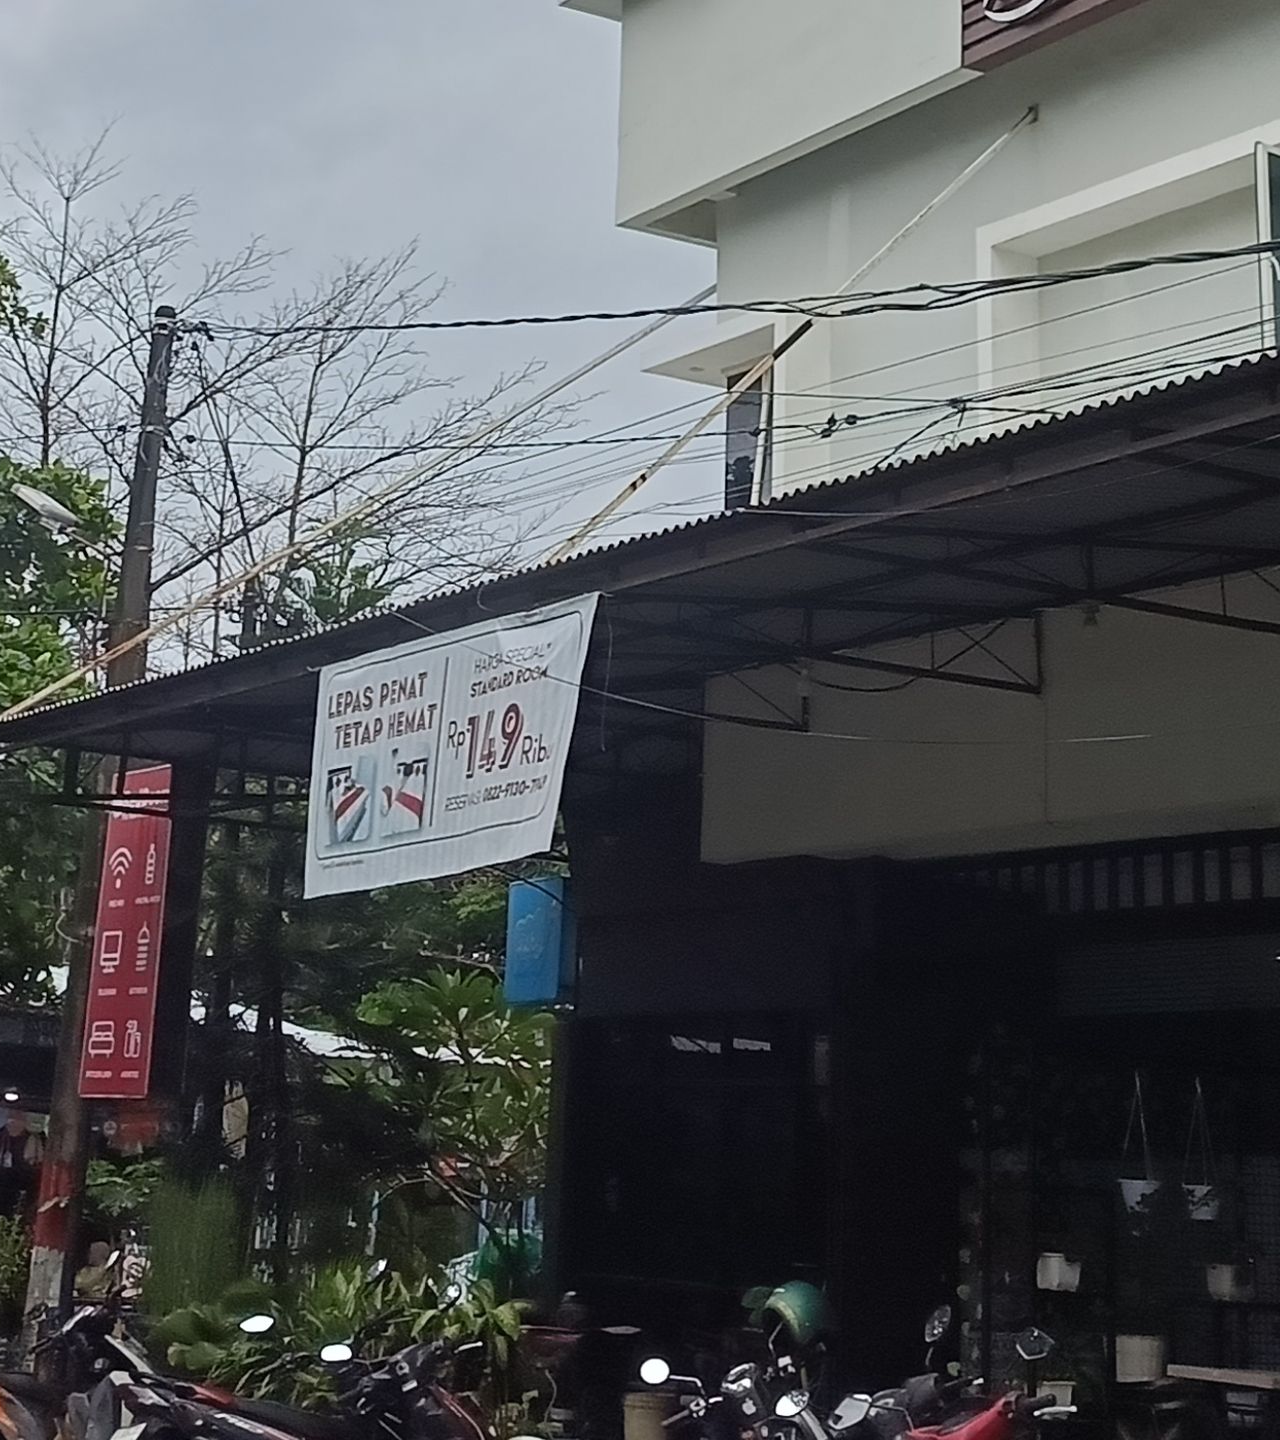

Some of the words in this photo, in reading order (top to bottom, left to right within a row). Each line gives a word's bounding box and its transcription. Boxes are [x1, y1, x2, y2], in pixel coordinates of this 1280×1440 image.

[328, 686, 374, 719] LEPAS
[380, 672, 428, 708] PENAT
[335, 717, 383, 750] TETAP
[387, 703, 438, 739] HEMAT
[447, 720, 466, 760] Rp
[466, 703, 525, 779] 149
